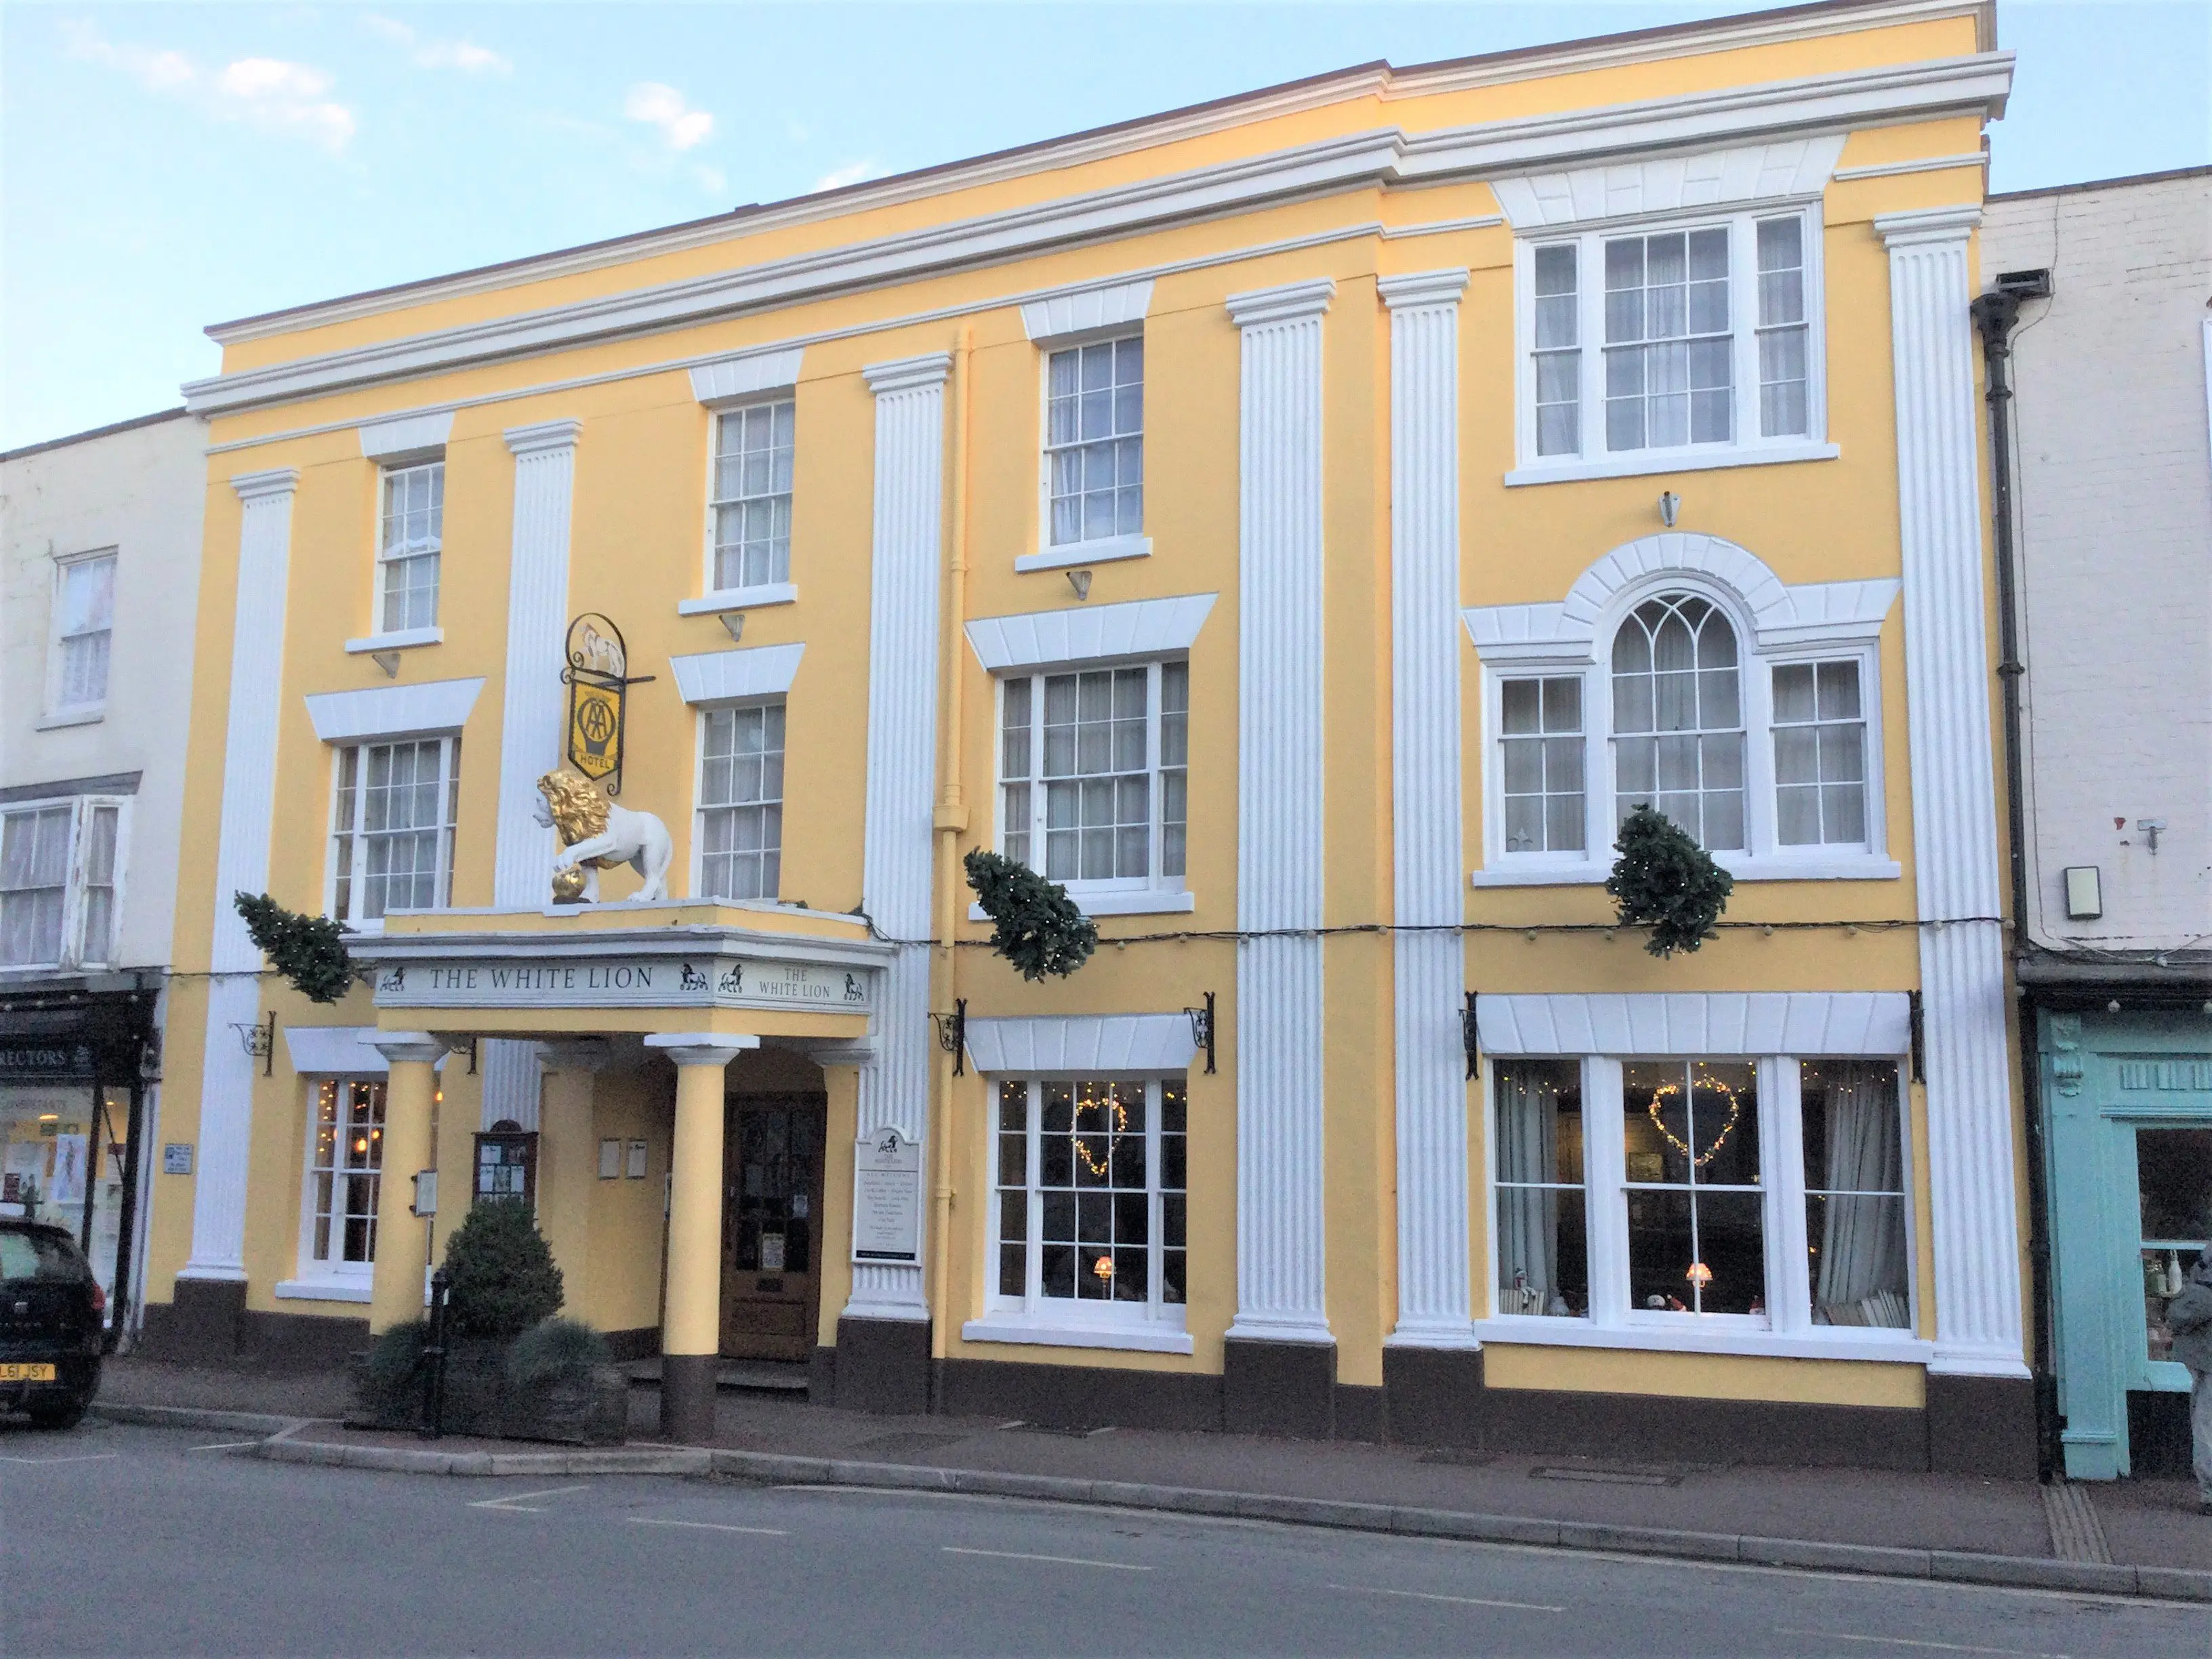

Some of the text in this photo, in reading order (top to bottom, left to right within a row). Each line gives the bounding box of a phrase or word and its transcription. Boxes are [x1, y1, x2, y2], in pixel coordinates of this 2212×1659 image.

[581, 754, 610, 769] HOTEL
[430, 966, 654, 989] THE WHITE LION
[784, 968, 808, 982] THE
[759, 981, 830, 998] WHITE LION
